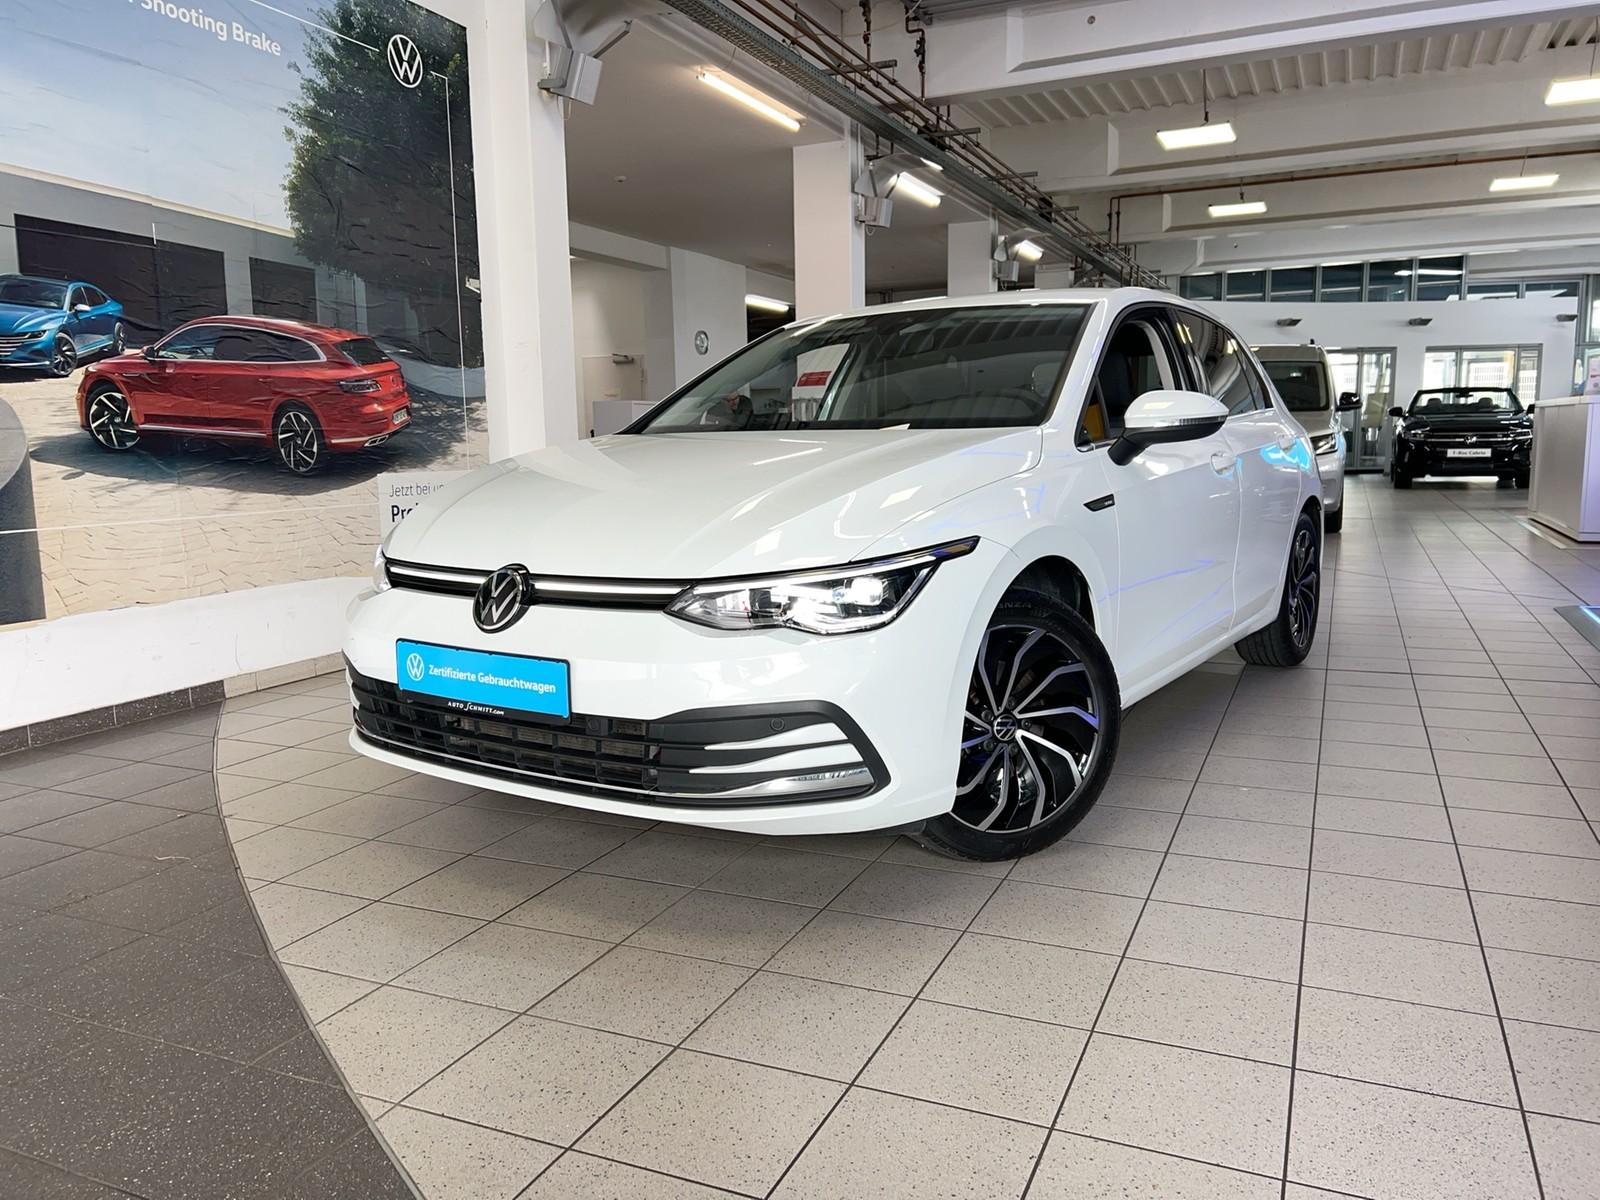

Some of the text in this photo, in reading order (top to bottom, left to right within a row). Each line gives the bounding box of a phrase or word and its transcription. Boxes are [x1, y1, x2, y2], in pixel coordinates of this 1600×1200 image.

[232, 22, 281, 56] Brake
[388, 34, 423, 88] VW
[389, 484, 413, 497] Jetzt
[416, 482, 431, 495] bei
[474, 570, 521, 627] VW
[429, 664, 556, 694] Zertifizierte Gebrauchtwagen
[447, 701, 464, 709] AUTO
